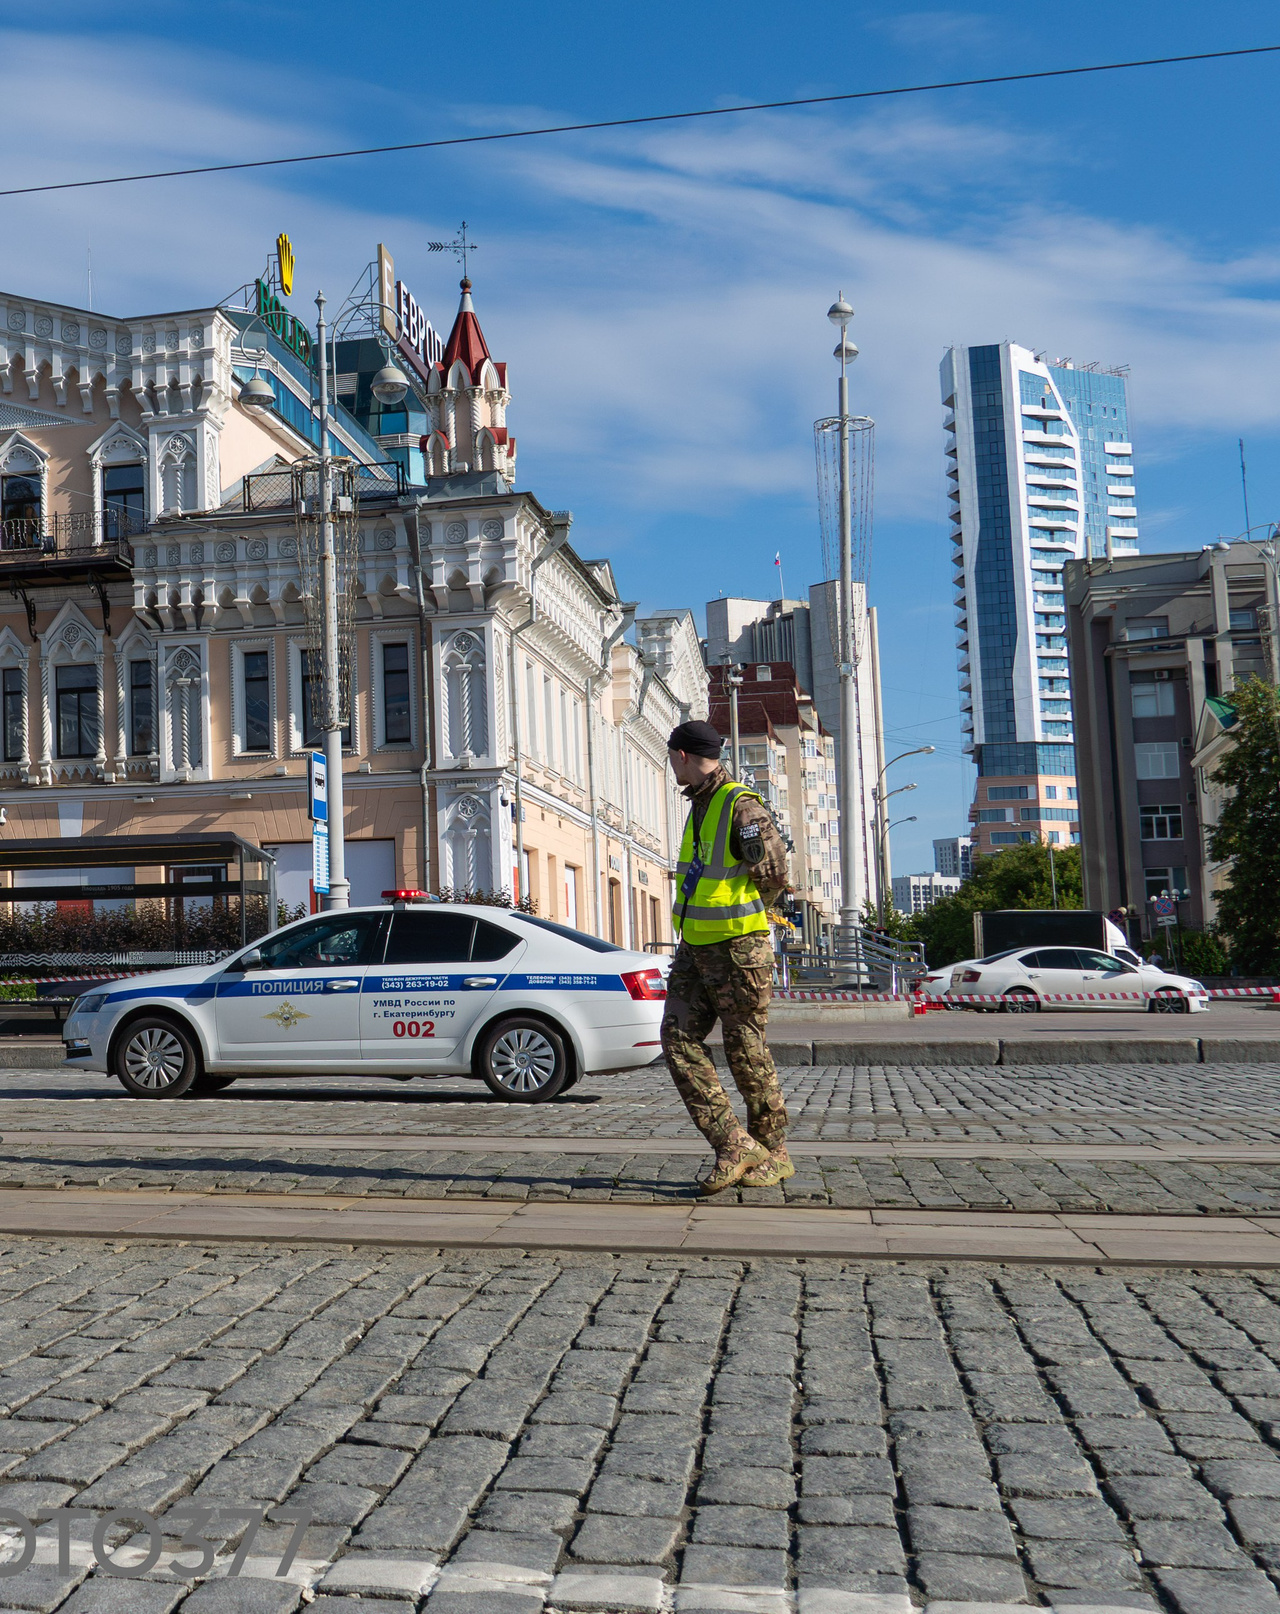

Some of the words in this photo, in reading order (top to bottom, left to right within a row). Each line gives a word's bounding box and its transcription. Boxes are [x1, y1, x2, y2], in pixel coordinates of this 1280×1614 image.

[256, 279, 315, 367] ROLEX
[397, 281, 446, 369] ЕВРОП
[252, 980, 324, 994] ПОЛИЦИЯ
[381, 981, 404, 990] (343)
[406, 980, 449, 988] 263-19-02
[373, 999, 402, 1008] УМВД
[404, 999, 441, 1007] России
[383, 1009, 456, 1019] Екатеринбургу
[392, 1020, 436, 1038] 002
